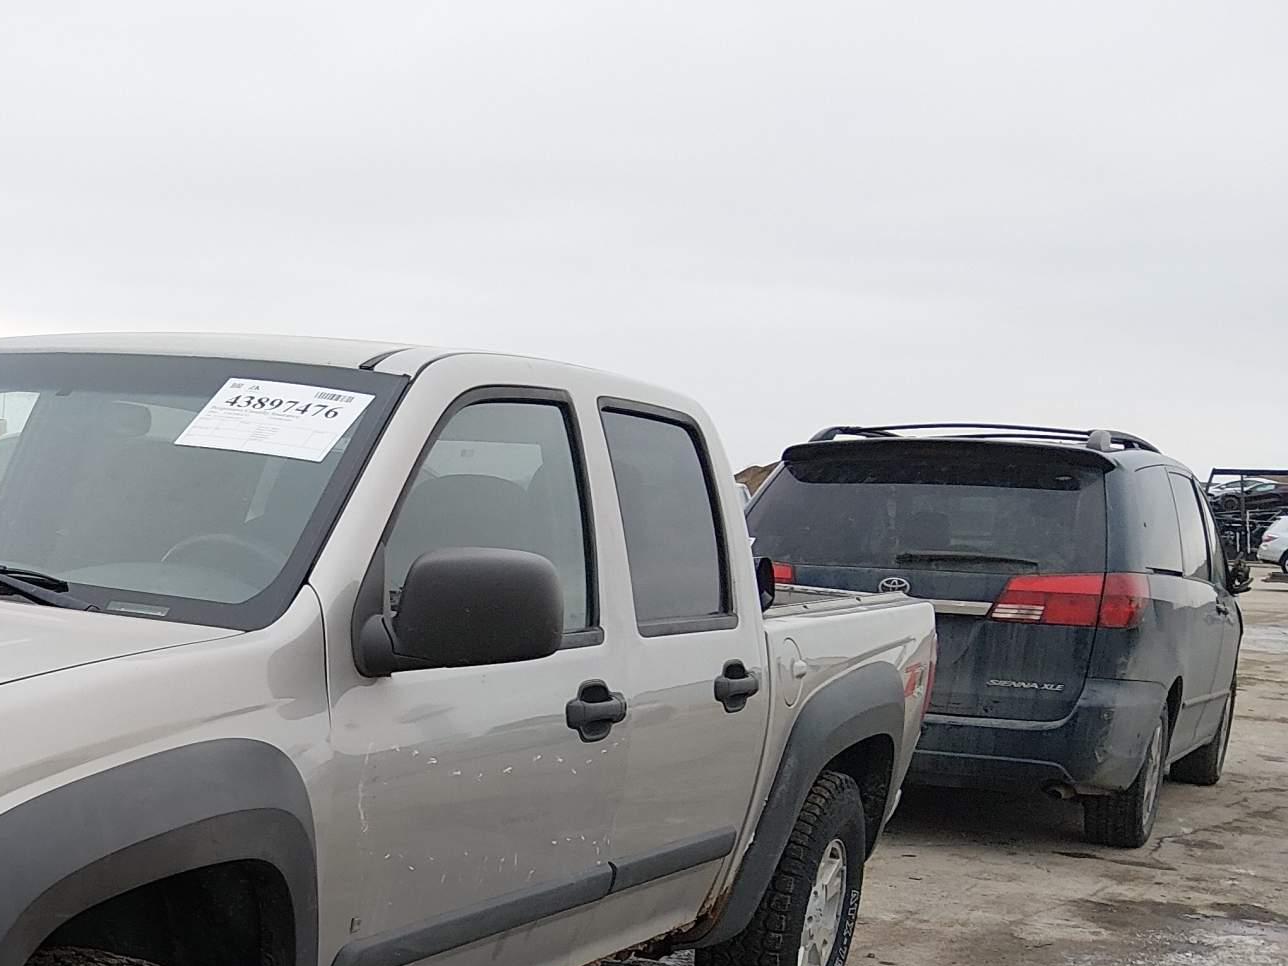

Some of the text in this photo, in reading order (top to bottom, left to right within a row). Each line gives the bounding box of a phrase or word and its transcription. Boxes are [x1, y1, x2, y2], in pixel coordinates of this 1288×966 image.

[225, 394, 344, 419] 43897476
[985, 679, 1065, 692] SIENNA XLE
